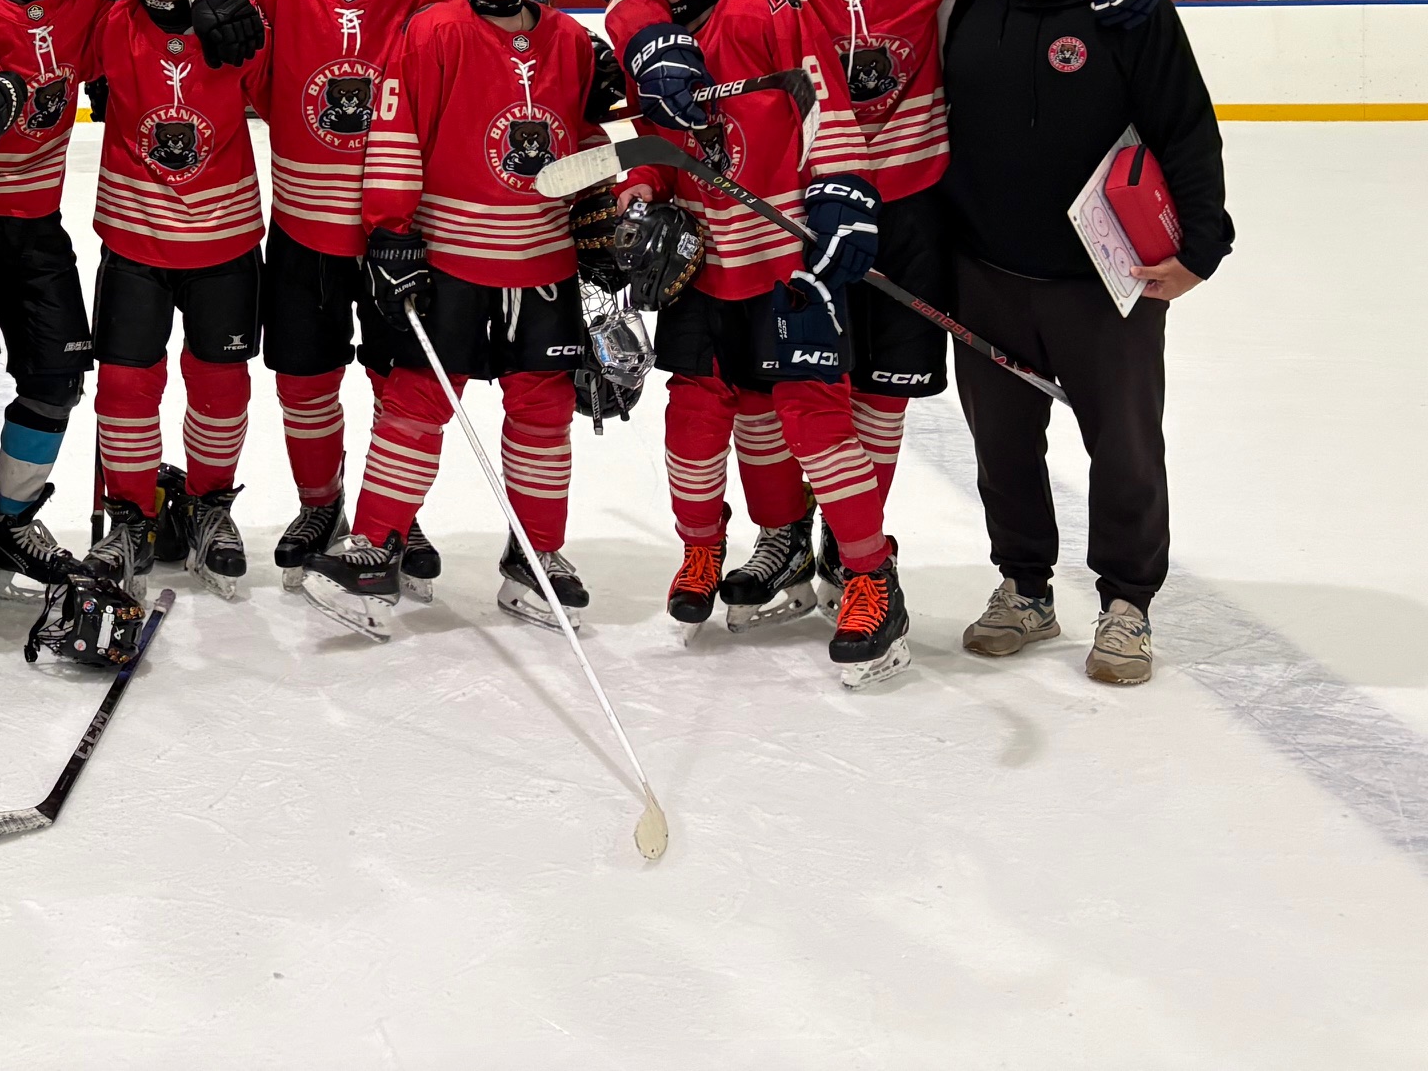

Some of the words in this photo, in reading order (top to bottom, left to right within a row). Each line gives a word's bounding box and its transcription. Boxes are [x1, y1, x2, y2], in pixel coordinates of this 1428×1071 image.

[140, 109, 212, 139] BRITANNIA
[307, 105, 341, 147] HOCKEY
[490, 108, 565, 139] BRITANNIA
[489, 149, 525, 189] HOCKEY
[804, 183, 876, 209] CCM
[394, 281, 416, 295] ALPHA
[911, 298, 966, 338] BAUER
[872, 371, 932, 385] CCM
[74, 711, 109, 760] CCM
